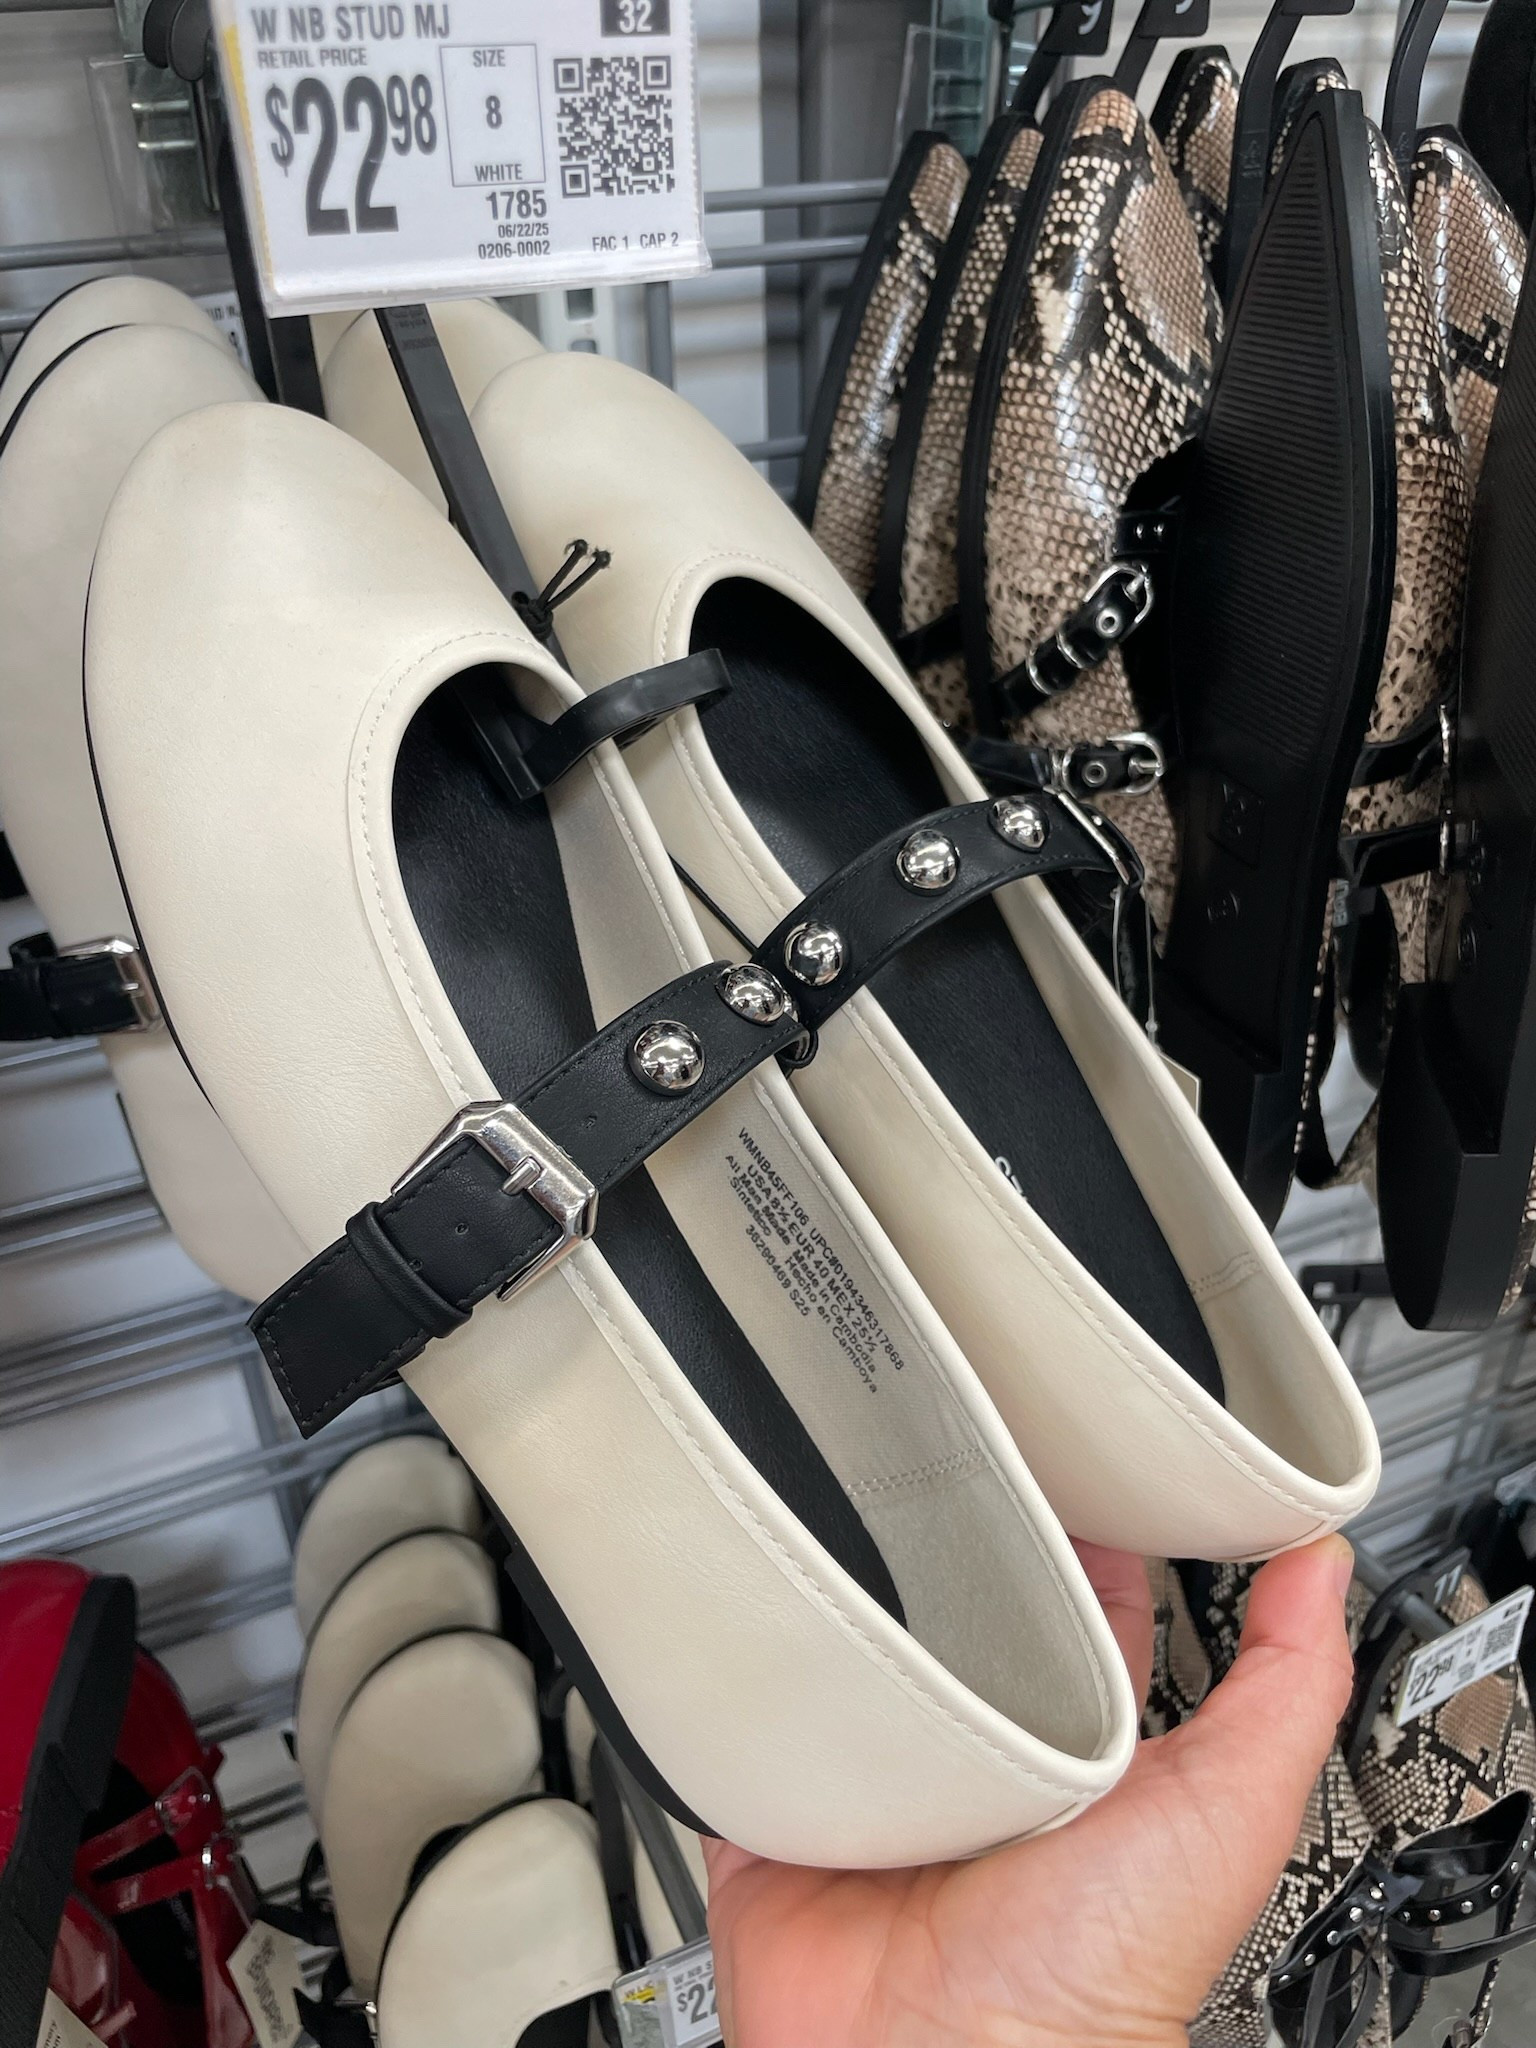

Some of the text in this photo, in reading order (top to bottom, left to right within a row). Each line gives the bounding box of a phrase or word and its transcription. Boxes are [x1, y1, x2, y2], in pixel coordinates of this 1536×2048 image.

[251, 4, 450, 44] W NB STUD MJ
[618, 0, 652, 33] 32
[257, 48, 368, 70] RETAIL PRICE
[472, 48, 506, 68] SIZE
[485, 95, 502, 130] 8
[475, 163, 523, 182] WHITE
[486, 189, 547, 220] 1785
[498, 222, 549, 238] 06/22/25
[592, 231, 680, 252] FAC 1 CAP 2
[478, 240, 550, 260] 0206-0002
[739, 1127, 810, 1226] WMNB45FF106
[747, 1164, 772, 1200] USA
[788, 1222, 815, 1260] EUR
[813, 1259, 830, 1279] 40
[827, 1278, 855, 1318] MEX
[725, 1155, 876, 1373] All Man Made Made in Cambodia
[789, 1289, 811, 1317] S25
[785, 1256, 817, 1303] Hecho
[818, 1305, 832, 1324] en
[832, 1325, 877, 1394] Camboya
[1434, 1563, 1463, 1605] 11
